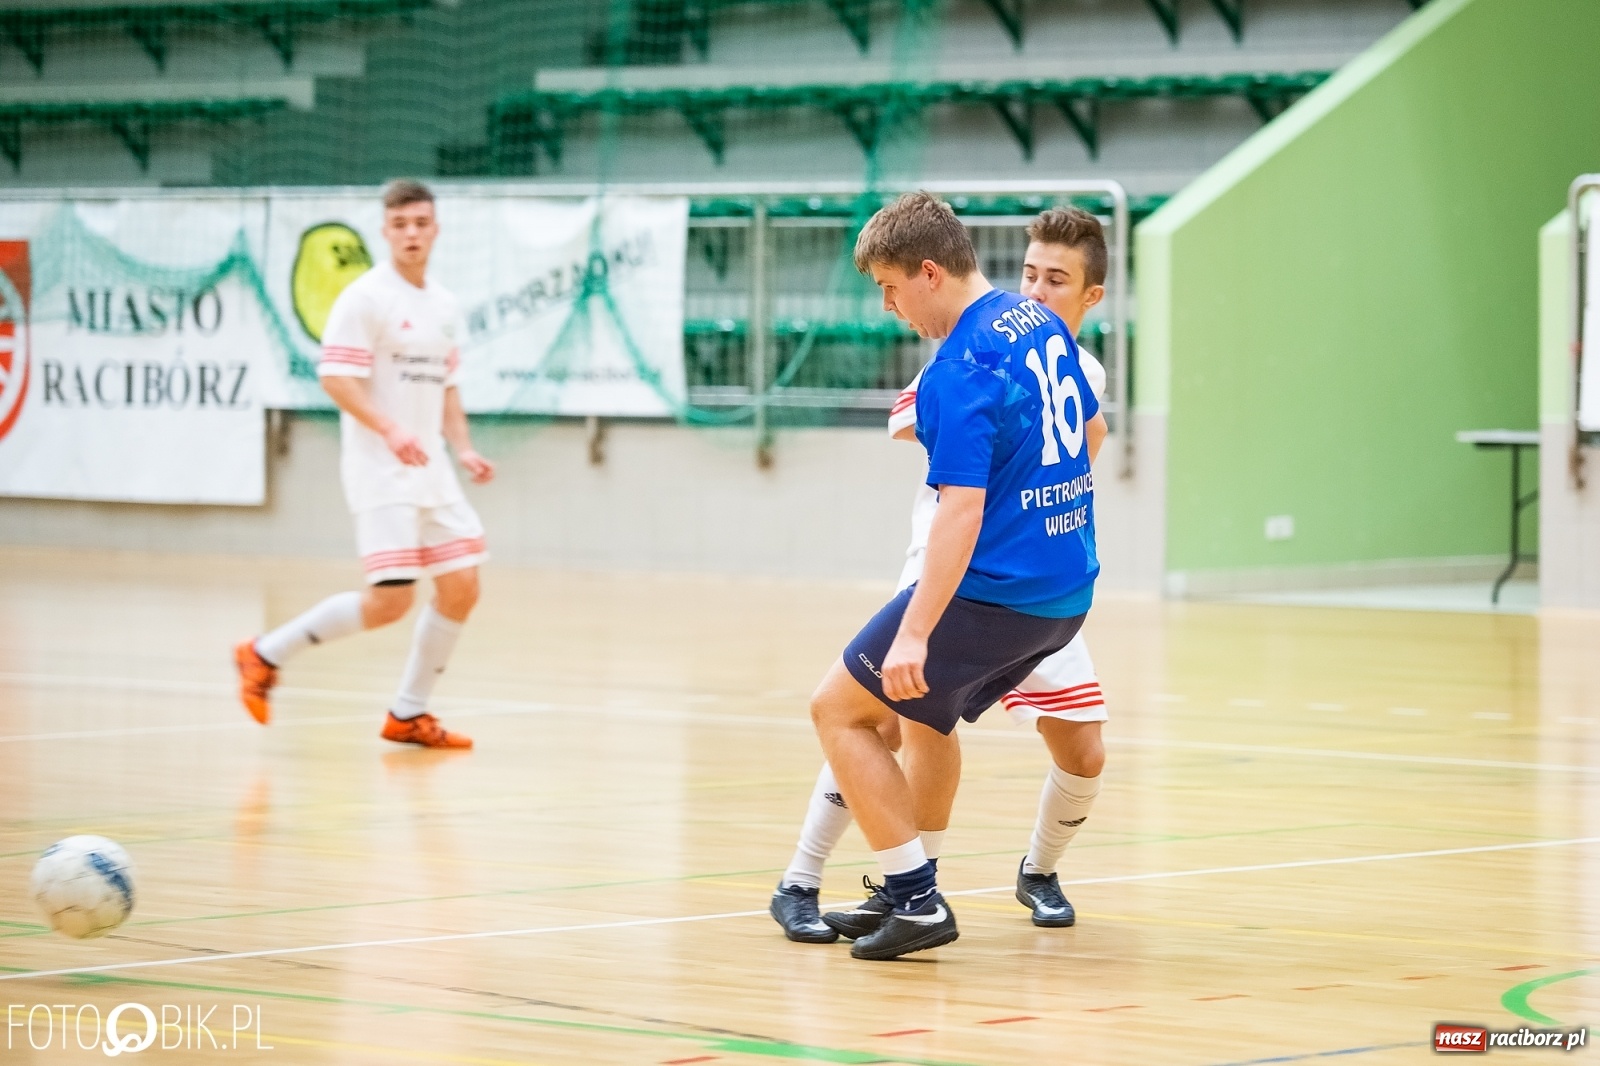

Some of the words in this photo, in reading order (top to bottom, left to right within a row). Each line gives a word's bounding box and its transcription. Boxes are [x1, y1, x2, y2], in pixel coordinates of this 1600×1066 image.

[66, 285, 223, 337] MIASTO
[992, 299, 1051, 344] START
[42, 347, 251, 411] RACIBÓRZ
[1025, 334, 1084, 467] 16
[1020, 472, 1093, 510] PIETROWICE
[1045, 504, 1087, 537] WIELKIE
